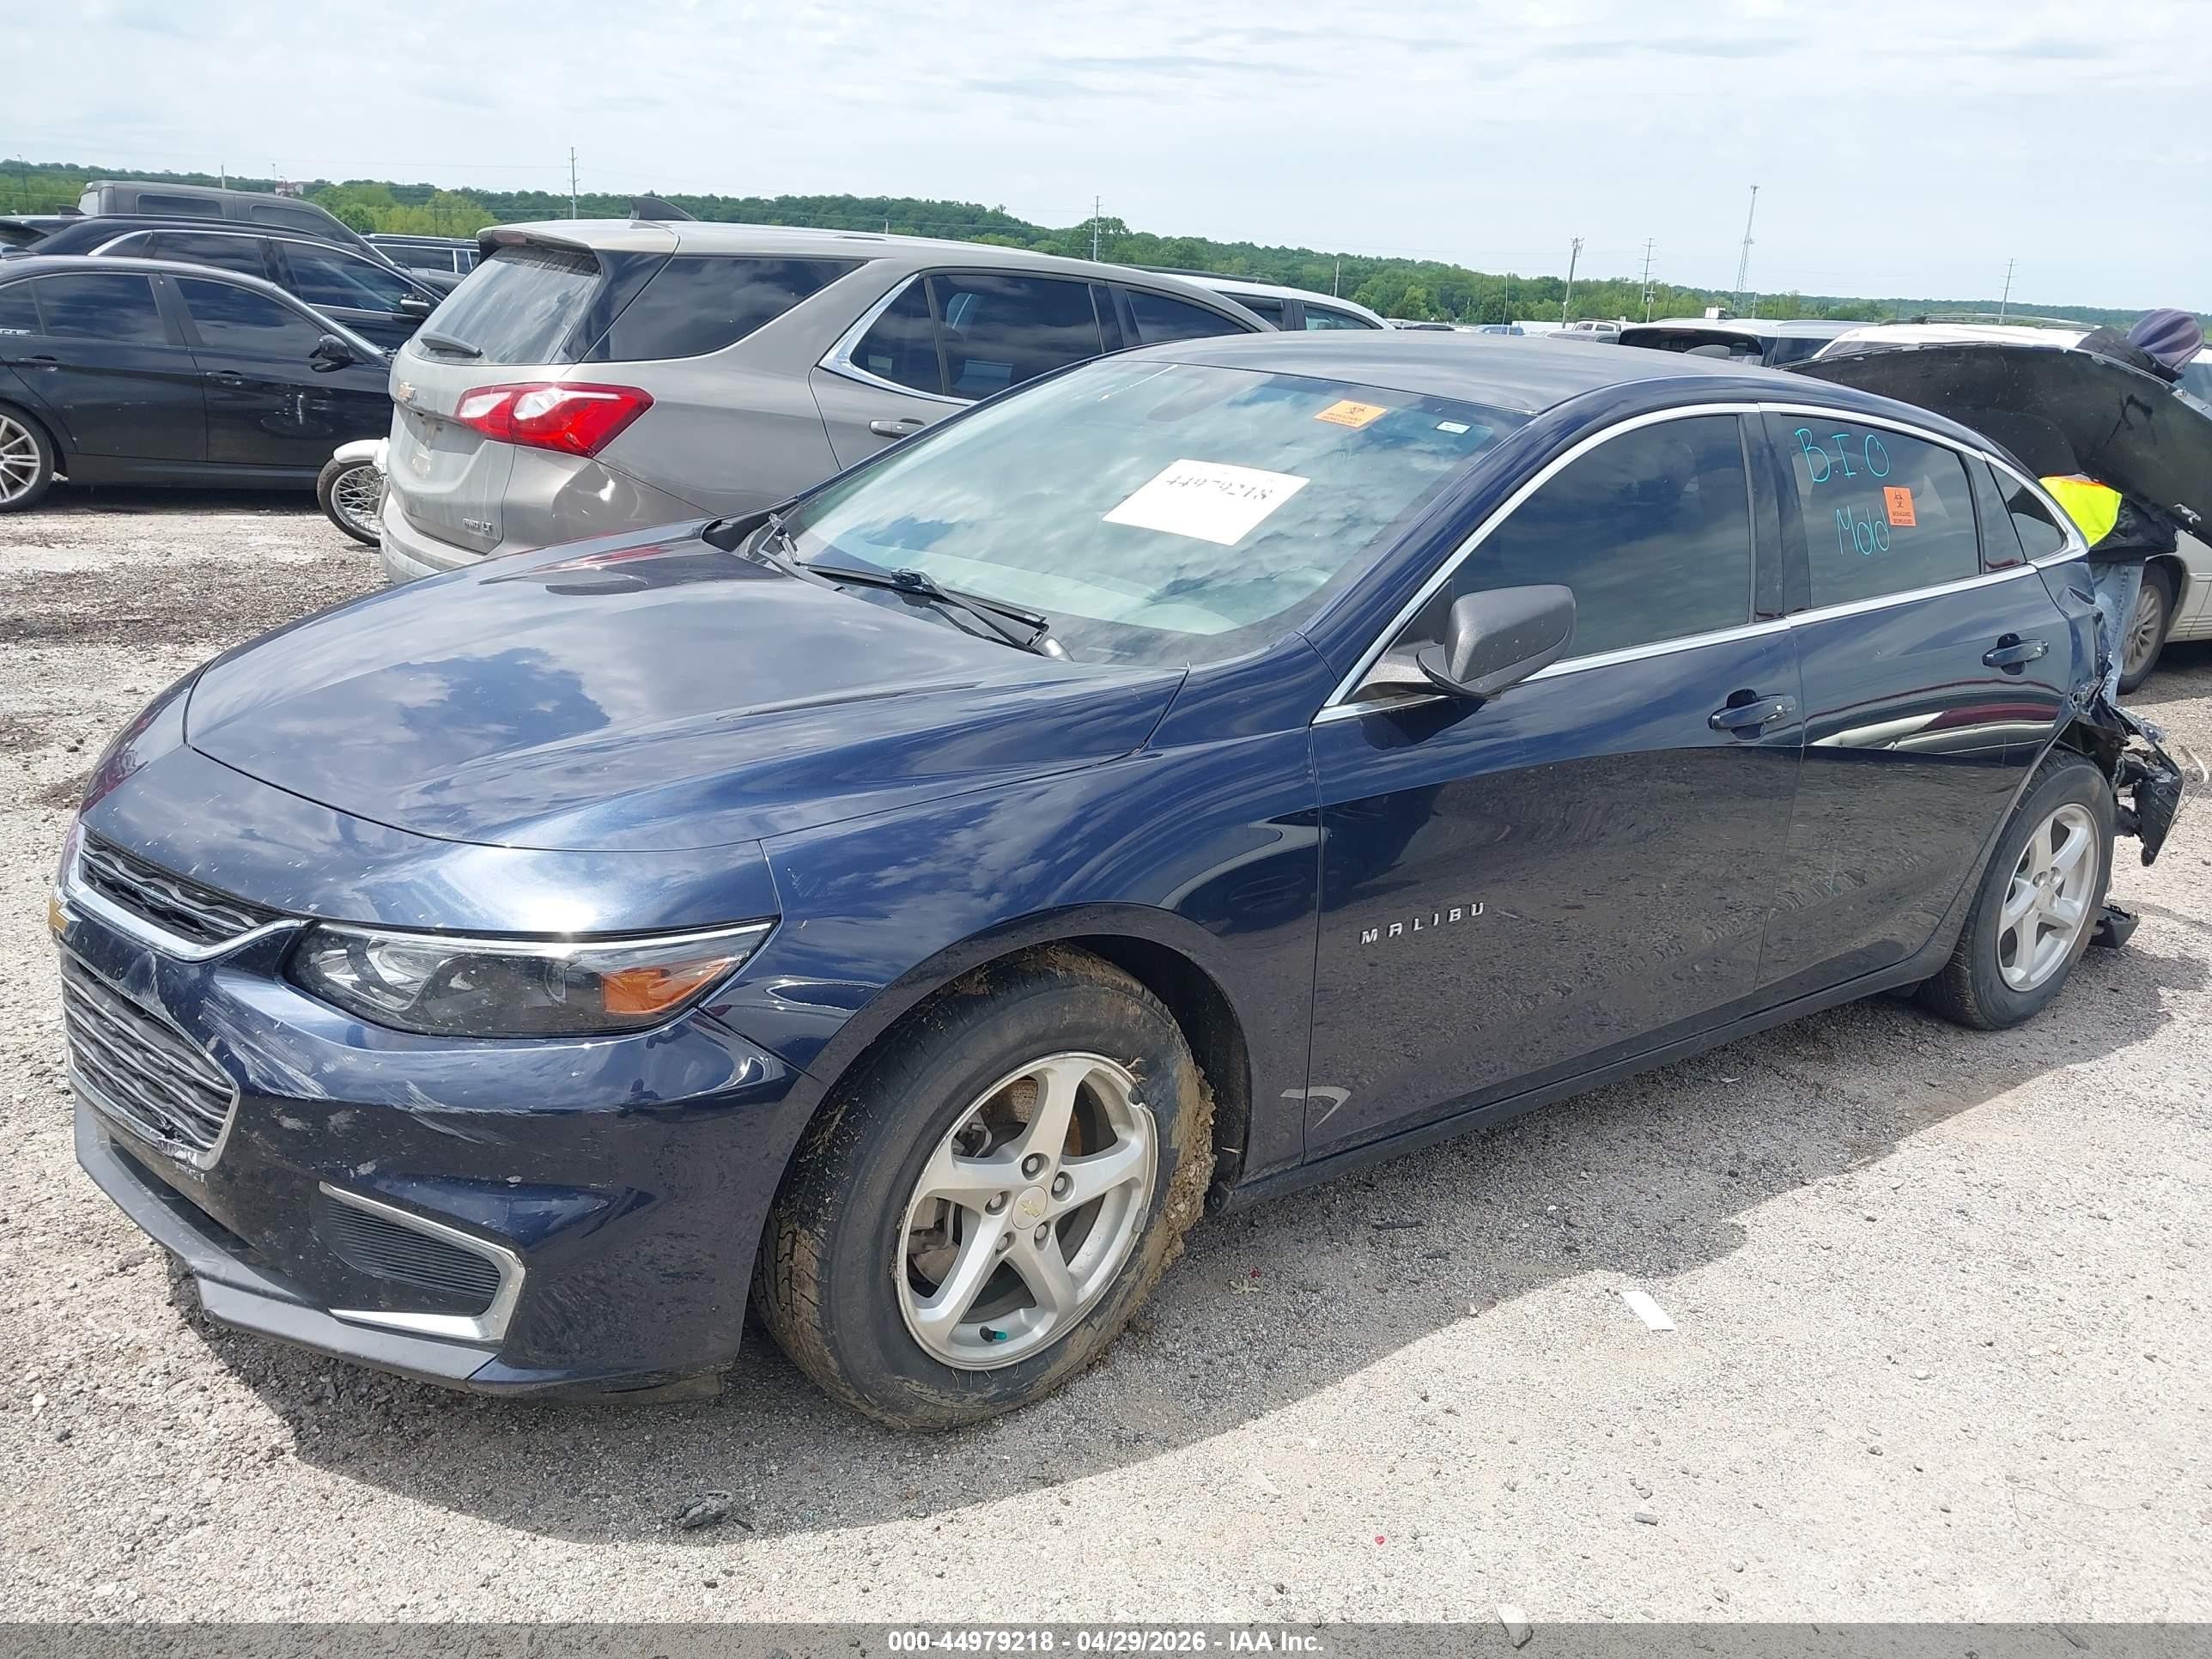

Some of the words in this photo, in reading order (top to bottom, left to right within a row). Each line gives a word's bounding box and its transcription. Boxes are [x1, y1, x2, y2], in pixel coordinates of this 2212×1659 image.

[481, 520, 492, 536] LT
[1835, 504, 1891, 556] Mold
[1360, 902, 1485, 945] MALIBU
